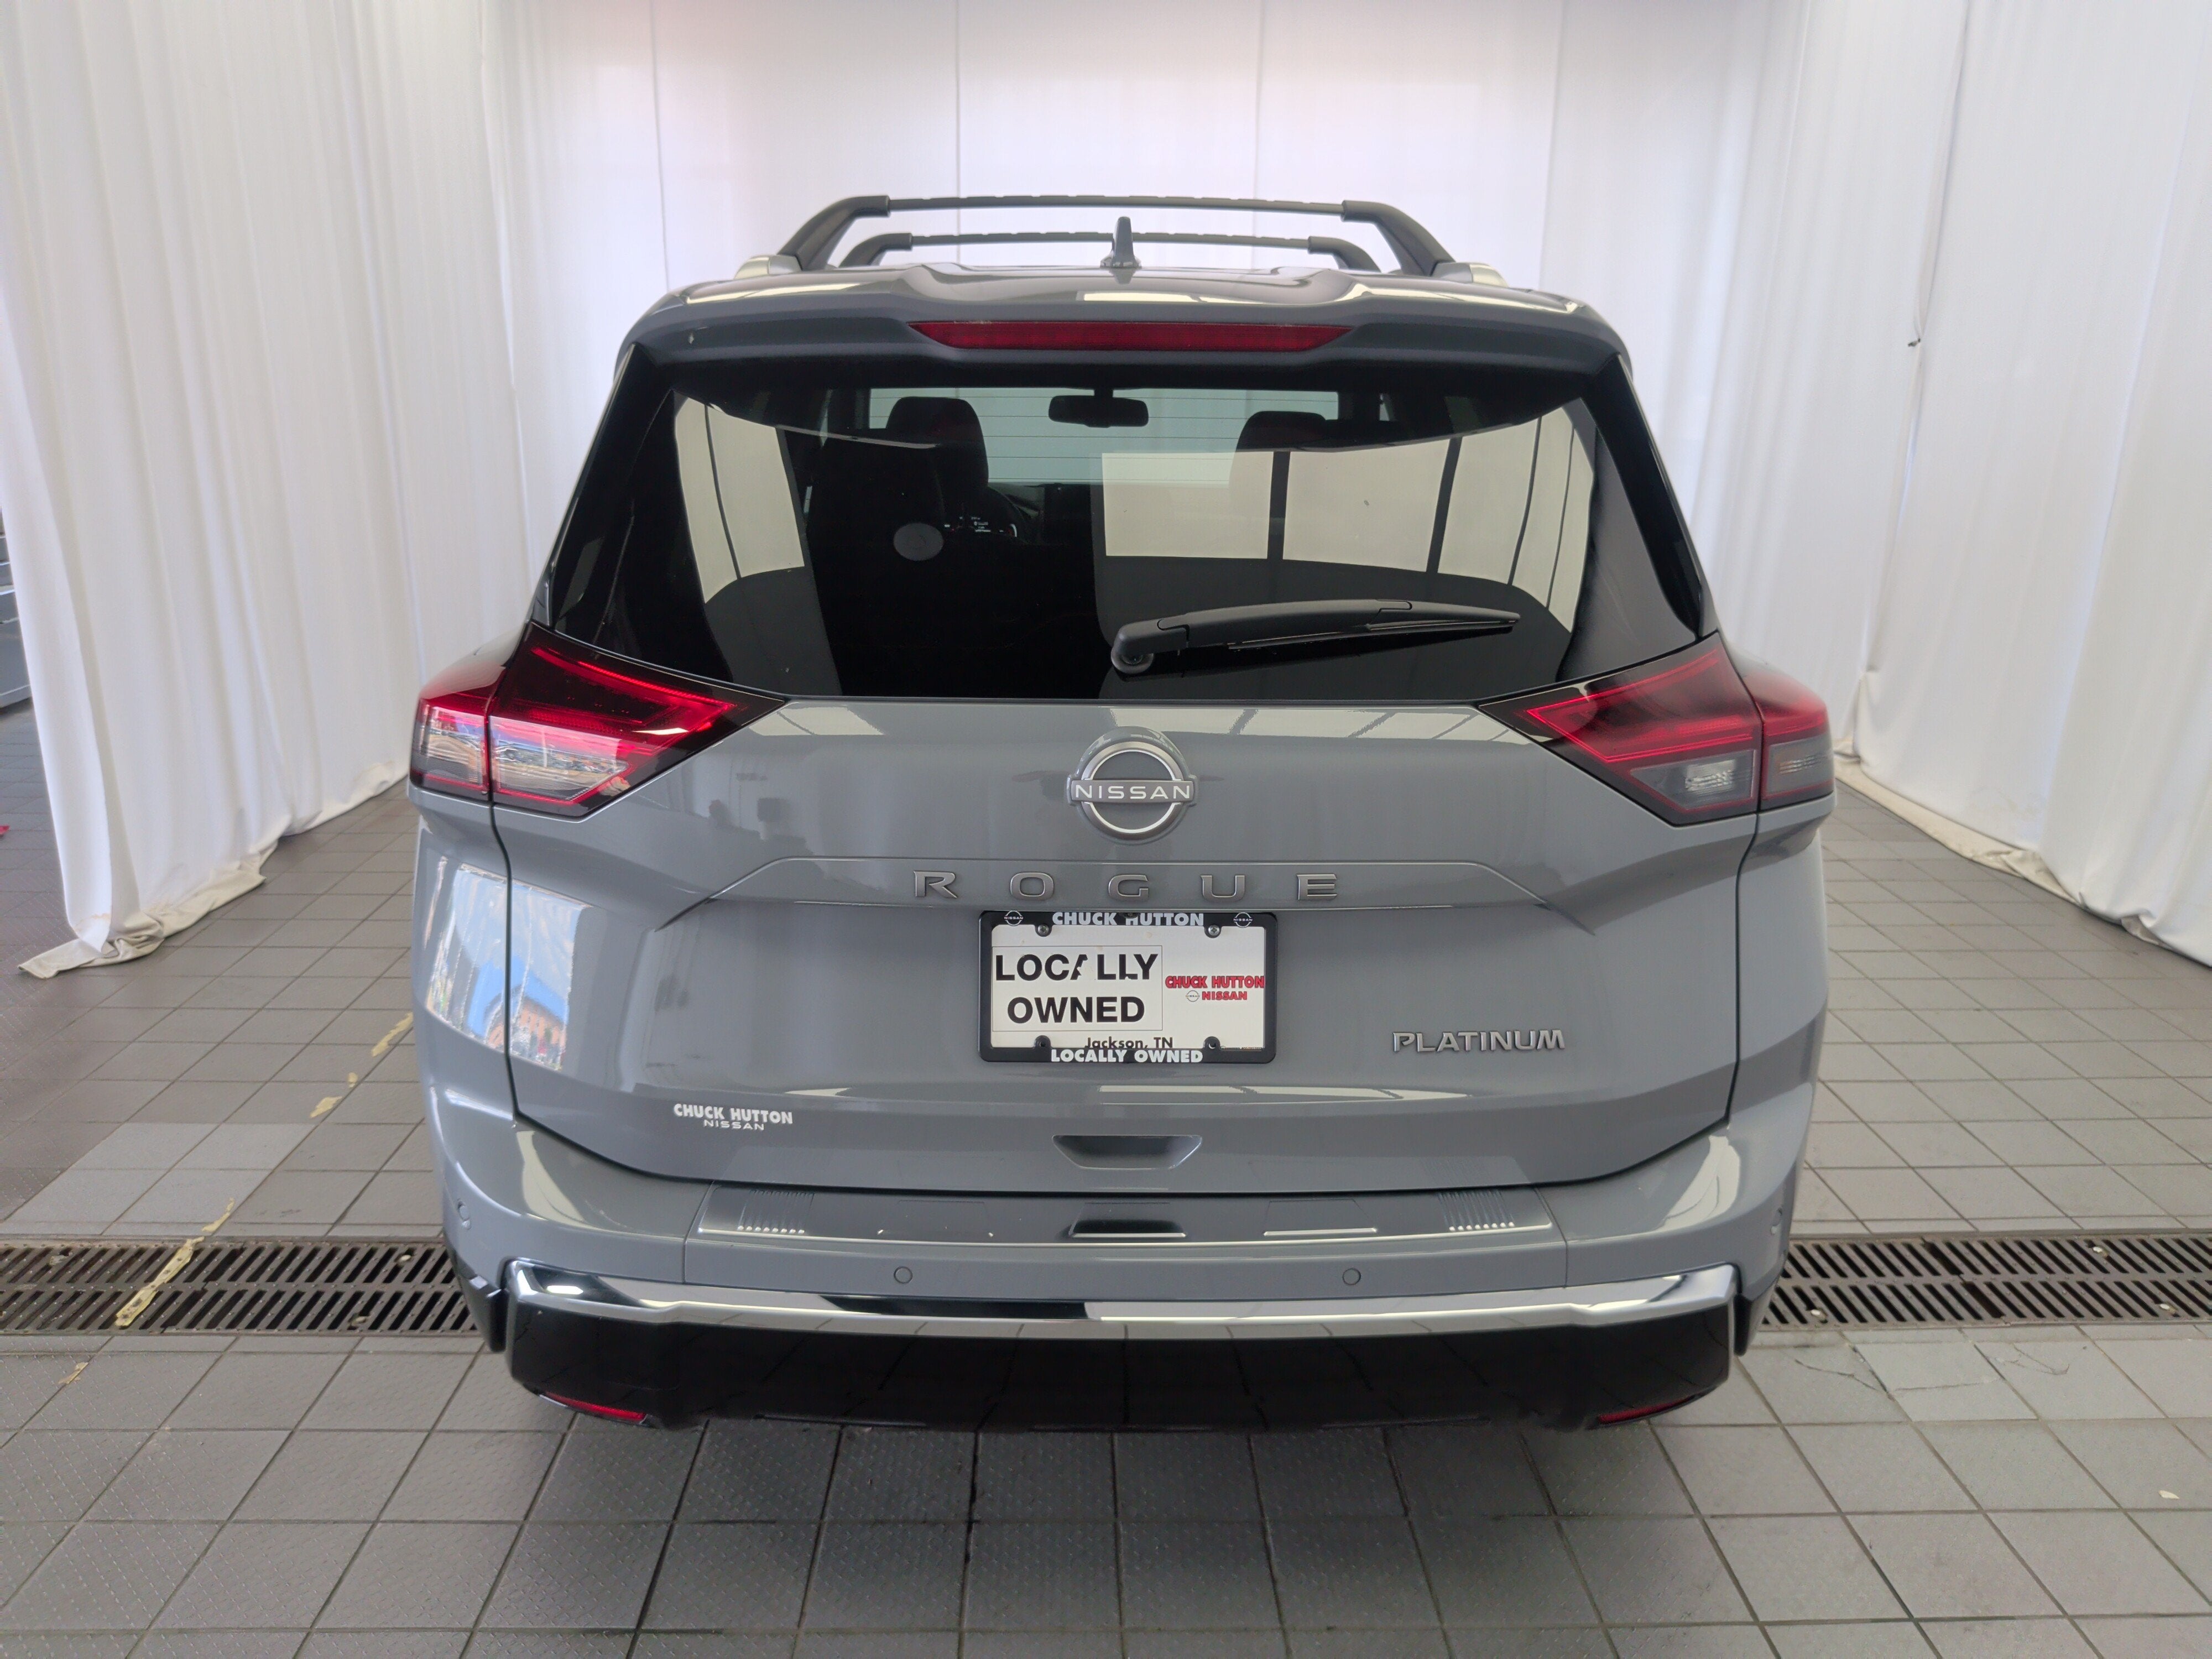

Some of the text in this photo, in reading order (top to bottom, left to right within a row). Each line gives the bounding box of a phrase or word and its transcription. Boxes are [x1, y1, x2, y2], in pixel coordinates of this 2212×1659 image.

[1075, 785, 1190, 800] NISSAN
[914, 870, 1338, 901] ROGUE
[1052, 912, 1204, 926] CHUCK HUTTON
[1165, 975, 1265, 989] CHUCK HUTTON
[1202, 991, 1248, 1000] NISSAN
[1007, 996, 1145, 1024] OWNED
[1084, 1036, 1173, 1049] Jackson, TN
[1392, 1029, 1566, 1052] PLATINUM
[1051, 1048, 1203, 1063] LOCALLY OWNED
[673, 1103, 794, 1124] CHUCK HUTTON
[703, 1119, 765, 1131] NISSAN
